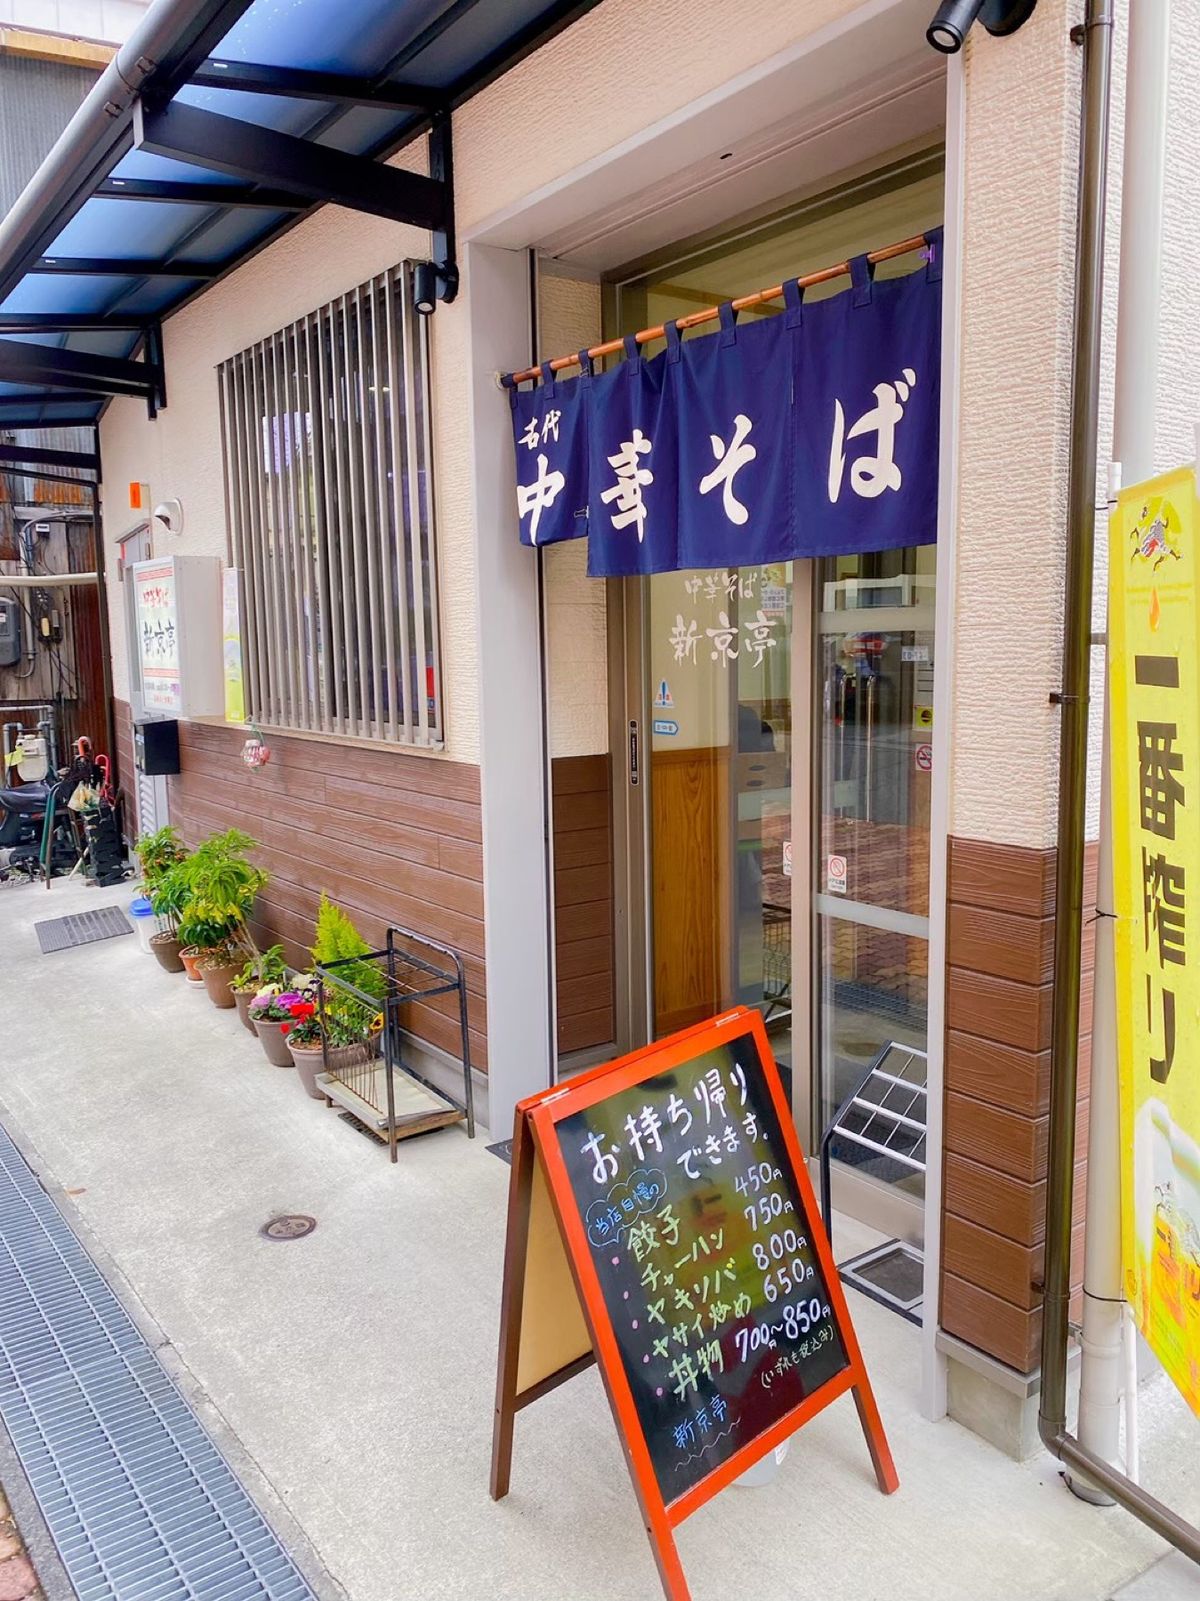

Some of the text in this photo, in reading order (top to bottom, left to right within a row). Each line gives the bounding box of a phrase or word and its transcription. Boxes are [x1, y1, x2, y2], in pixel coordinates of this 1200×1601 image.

[517, 368, 917, 546] 中華そば
[685, 572, 757, 604] 中華そば
[669, 610, 777, 668] 新京亭
[1134, 655, 1187, 1085] 一番搾り
[580, 1063, 748, 1184] お持ち帰り
[595, 1181, 660, 1236] 当店自慢の
[627, 1162, 782, 1262] 餃子 450円
[640, 1192, 794, 1291] チャーハン 750円
[647, 1229, 807, 1325] ヤキソバ 800円
[653, 1258, 814, 1358] ヤサイ炒め 650円
[669, 1339, 723, 1401] 丼物
[673, 1394, 727, 1448] 新京亭
